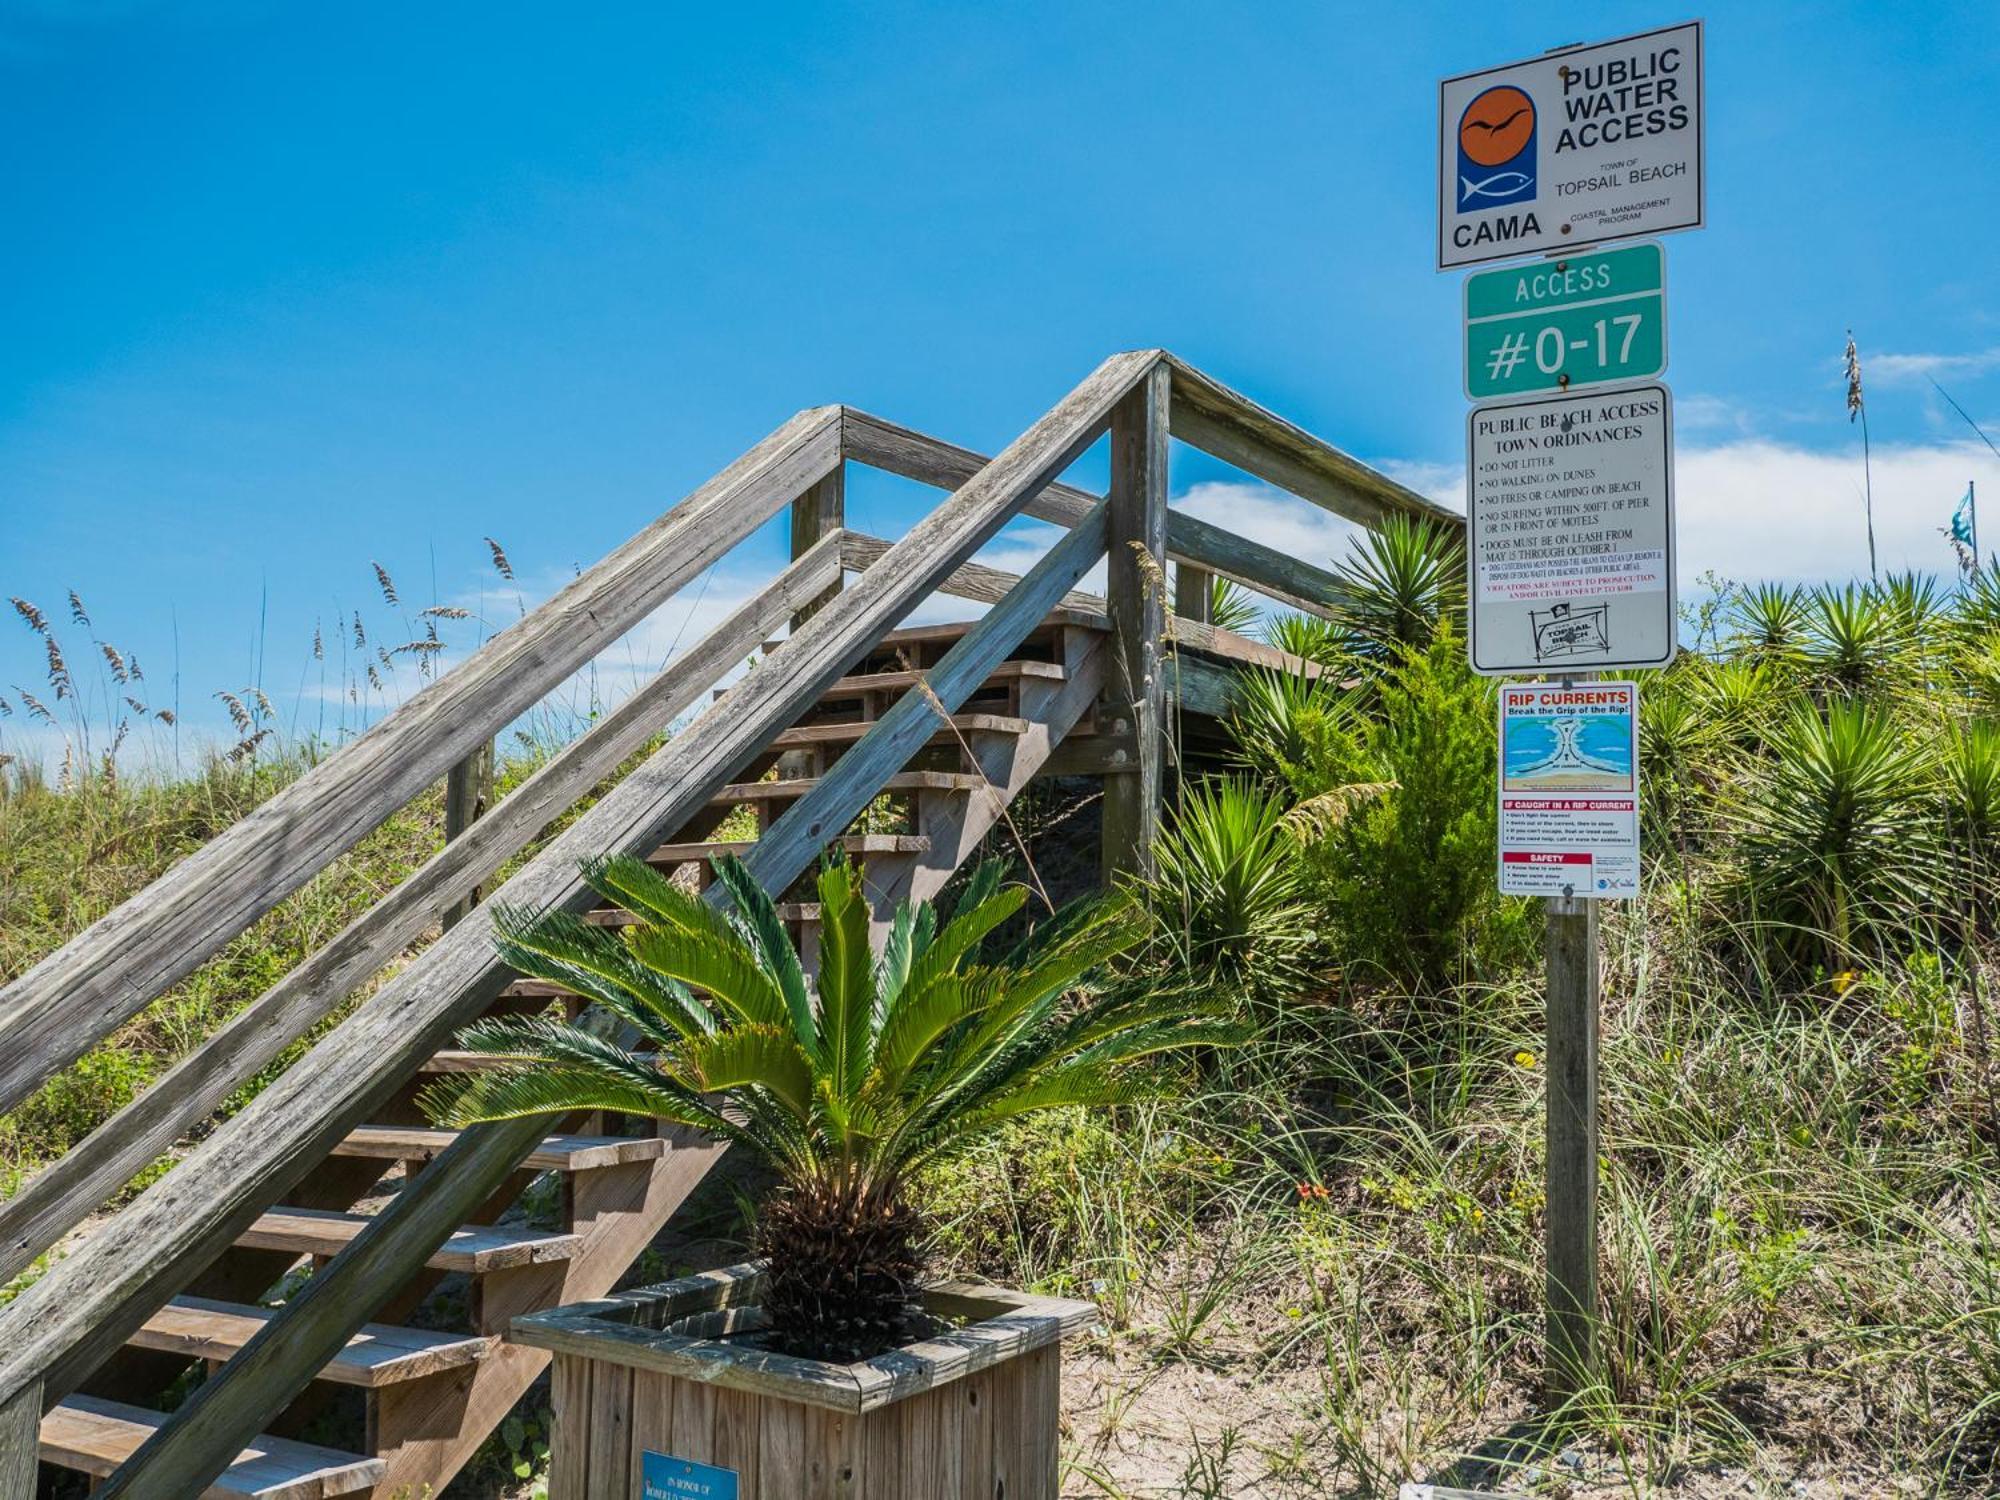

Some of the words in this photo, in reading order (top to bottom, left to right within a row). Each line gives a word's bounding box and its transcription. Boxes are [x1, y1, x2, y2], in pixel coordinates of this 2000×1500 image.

[1563, 48, 1681, 96] PUBLIC
[1565, 78, 1679, 123] WATER
[1555, 105, 1689, 154] ACCESS
[1600, 160, 1626, 171] TOWN
[1626, 158, 1639, 168] OF
[1555, 174, 1622, 197] TOPSAIL
[1629, 162, 1687, 184] BEACH
[1570, 209, 1608, 222] COASTAL
[1611, 198, 1671, 216] MANAGEMENT
[1598, 212, 1642, 226] PROGRAM
[1453, 212, 1542, 248] CAMA
[1515, 264, 1611, 302] ACCESS
[1479, 416, 1535, 436] PUBLIC
[1540, 409, 1592, 430] BEACH
[1598, 401, 1659, 421] ACCESS
[1495, 437, 1538, 454] TOWN
[1543, 425, 1643, 448] ORDINANCES
[1485, 462, 1499, 473] DO
[1501, 460, 1519, 471] NOT
[1521, 457, 1555, 468] LITTER
[1485, 479, 1499, 489] NO
[1501, 474, 1545, 487] WALKING
[1546, 472, 1560, 482] ON
[1563, 469, 1596, 481] DUNES
[1485, 495, 1499, 505] NO
[1501, 492, 1527, 504] FIRES
[1529, 490, 1542, 501] OR
[1544, 486, 1590, 500] CAMPING
[1591, 484, 1606, 495] ON
[1608, 481, 1641, 493] BEACH
[1485, 512, 1499, 522] NO
[1500, 507, 1542, 521] SURFING
[1544, 503, 1580, 516] WITHIN
[1612, 500, 1625, 511] OF
[1627, 497, 1650, 509] PIER
[1485, 524, 1498, 534] OR
[1501, 522, 1512, 533] IN
[1513, 520, 1545, 532] FRONT
[1546, 518, 1560, 528] OF
[1562, 515, 1599, 527] MOTELS
[1486, 540, 1511, 551] DOGS
[1513, 537, 1538, 548] MUST
[1541, 536, 1553, 546] BE
[1555, 534, 1569, 545] ON
[1572, 531, 1603, 544] LEASH
[1606, 529, 1633, 541] FROM
[1486, 553, 1506, 564] MAY
[1508, 551, 1517, 560] 15
[1518, 547, 1565, 561] THROUGH
[1567, 543, 1610, 557] OCTOBER
[1548, 623, 1591, 638] TOPSAIL
[1508, 694, 1535, 706] RIP
[1540, 692, 1628, 705] CURRENTS
[1508, 707, 1535, 715] Break
[1538, 706, 1553, 714] the
[1556, 706, 1577, 715] Grip
[1579, 706, 1588, 714] of
[1590, 705, 1606, 713] the
[1609, 705, 1628, 714] Rip!
[1530, 854, 1564, 863] SAFETY
